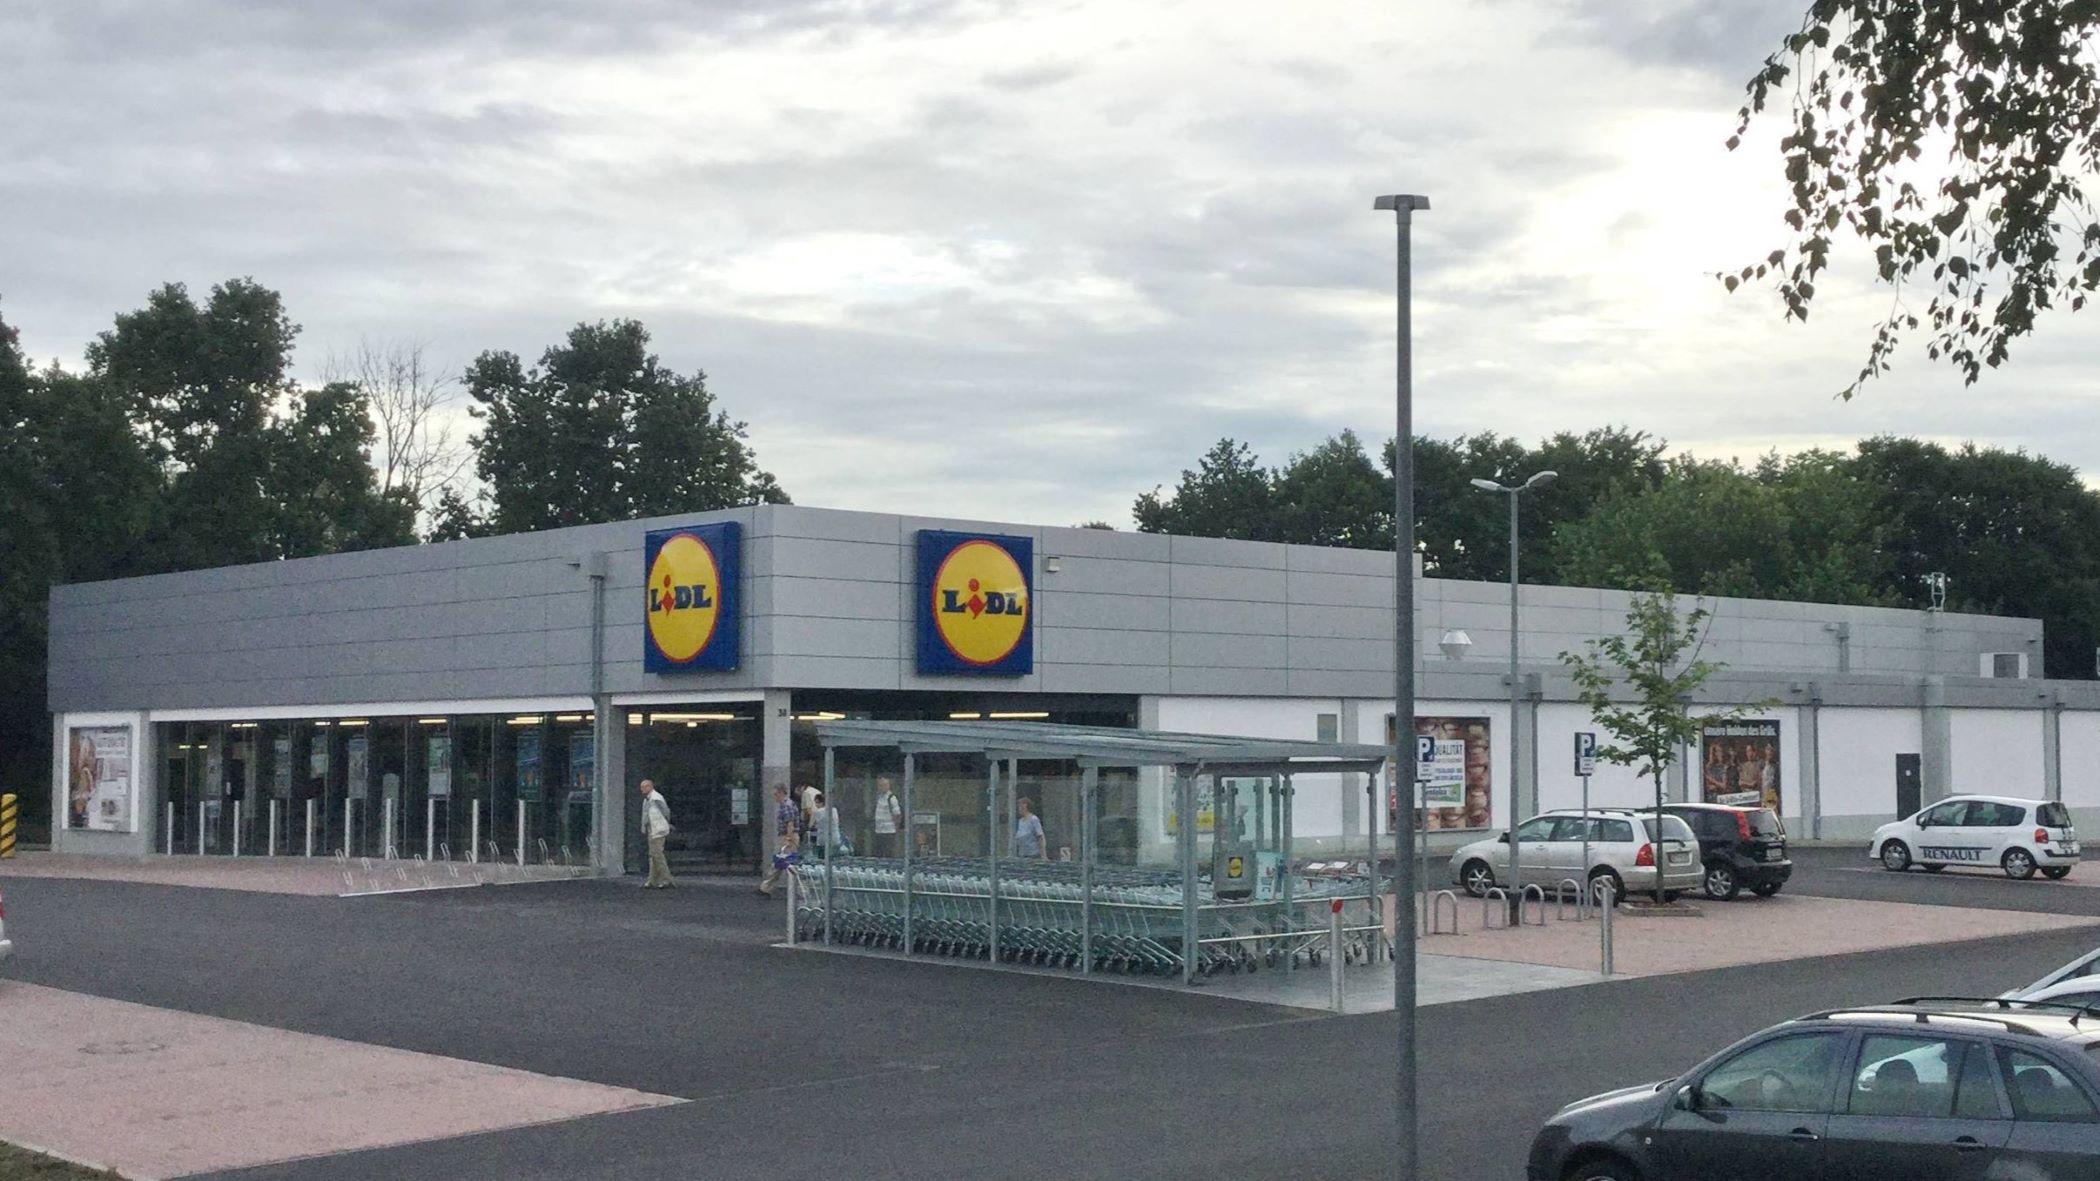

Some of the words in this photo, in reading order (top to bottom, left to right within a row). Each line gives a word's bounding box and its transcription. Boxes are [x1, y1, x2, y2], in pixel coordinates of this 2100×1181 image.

[1418, 738, 1431, 761] P
[1581, 735, 1592, 757] P
[1923, 848, 1982, 860] RENAULT
